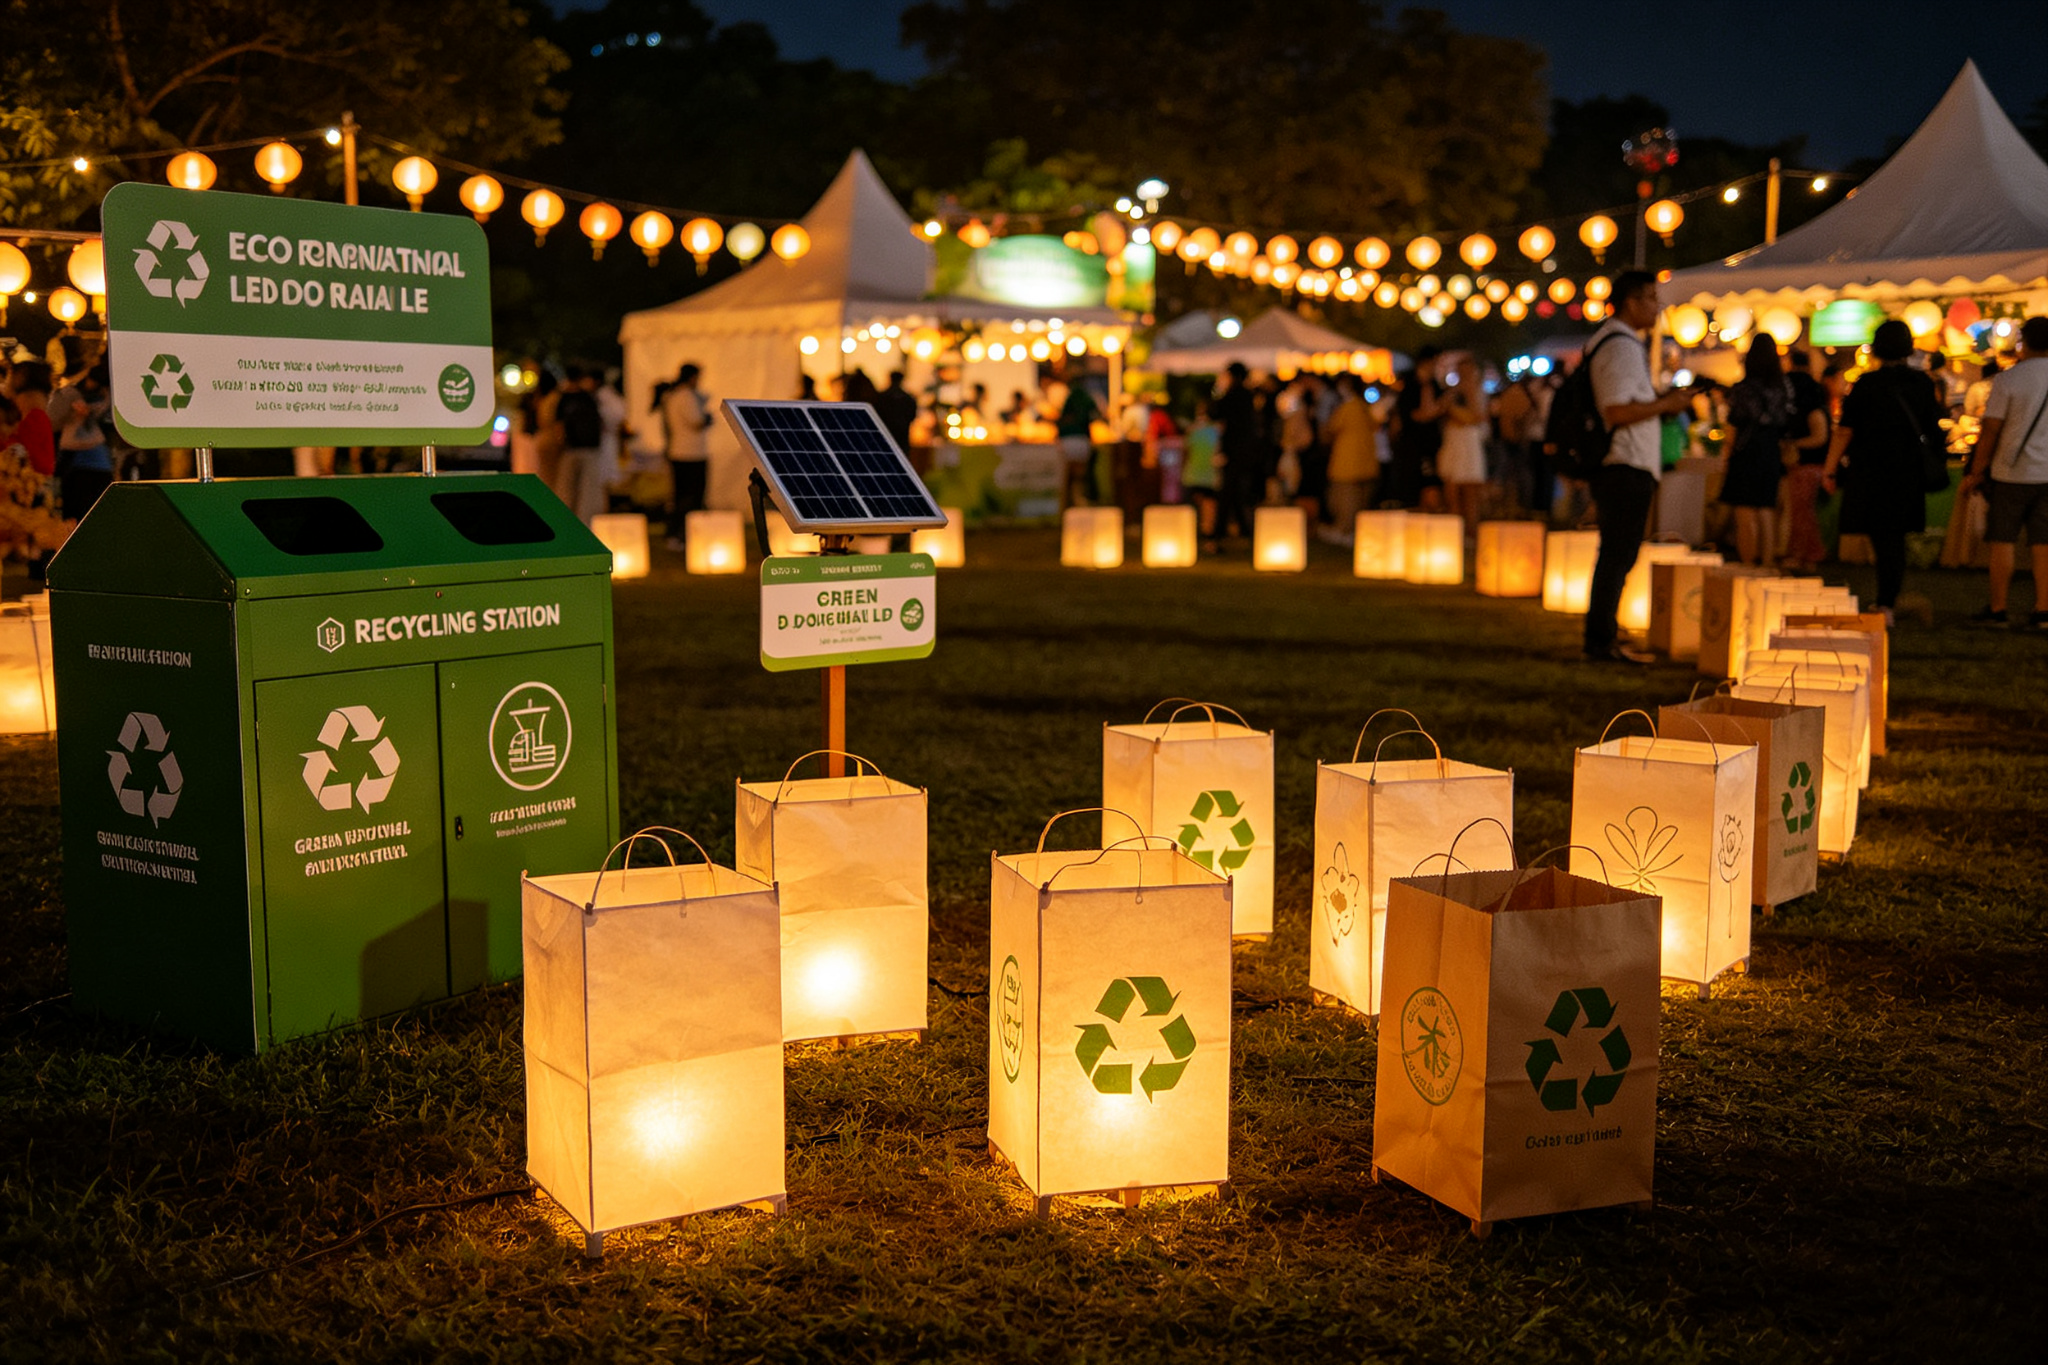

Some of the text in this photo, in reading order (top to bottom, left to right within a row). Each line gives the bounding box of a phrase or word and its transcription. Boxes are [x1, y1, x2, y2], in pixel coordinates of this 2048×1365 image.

[229, 231, 293, 265] ECO
[355, 611, 477, 644] RECYCLING
[482, 603, 561, 633] STATION
